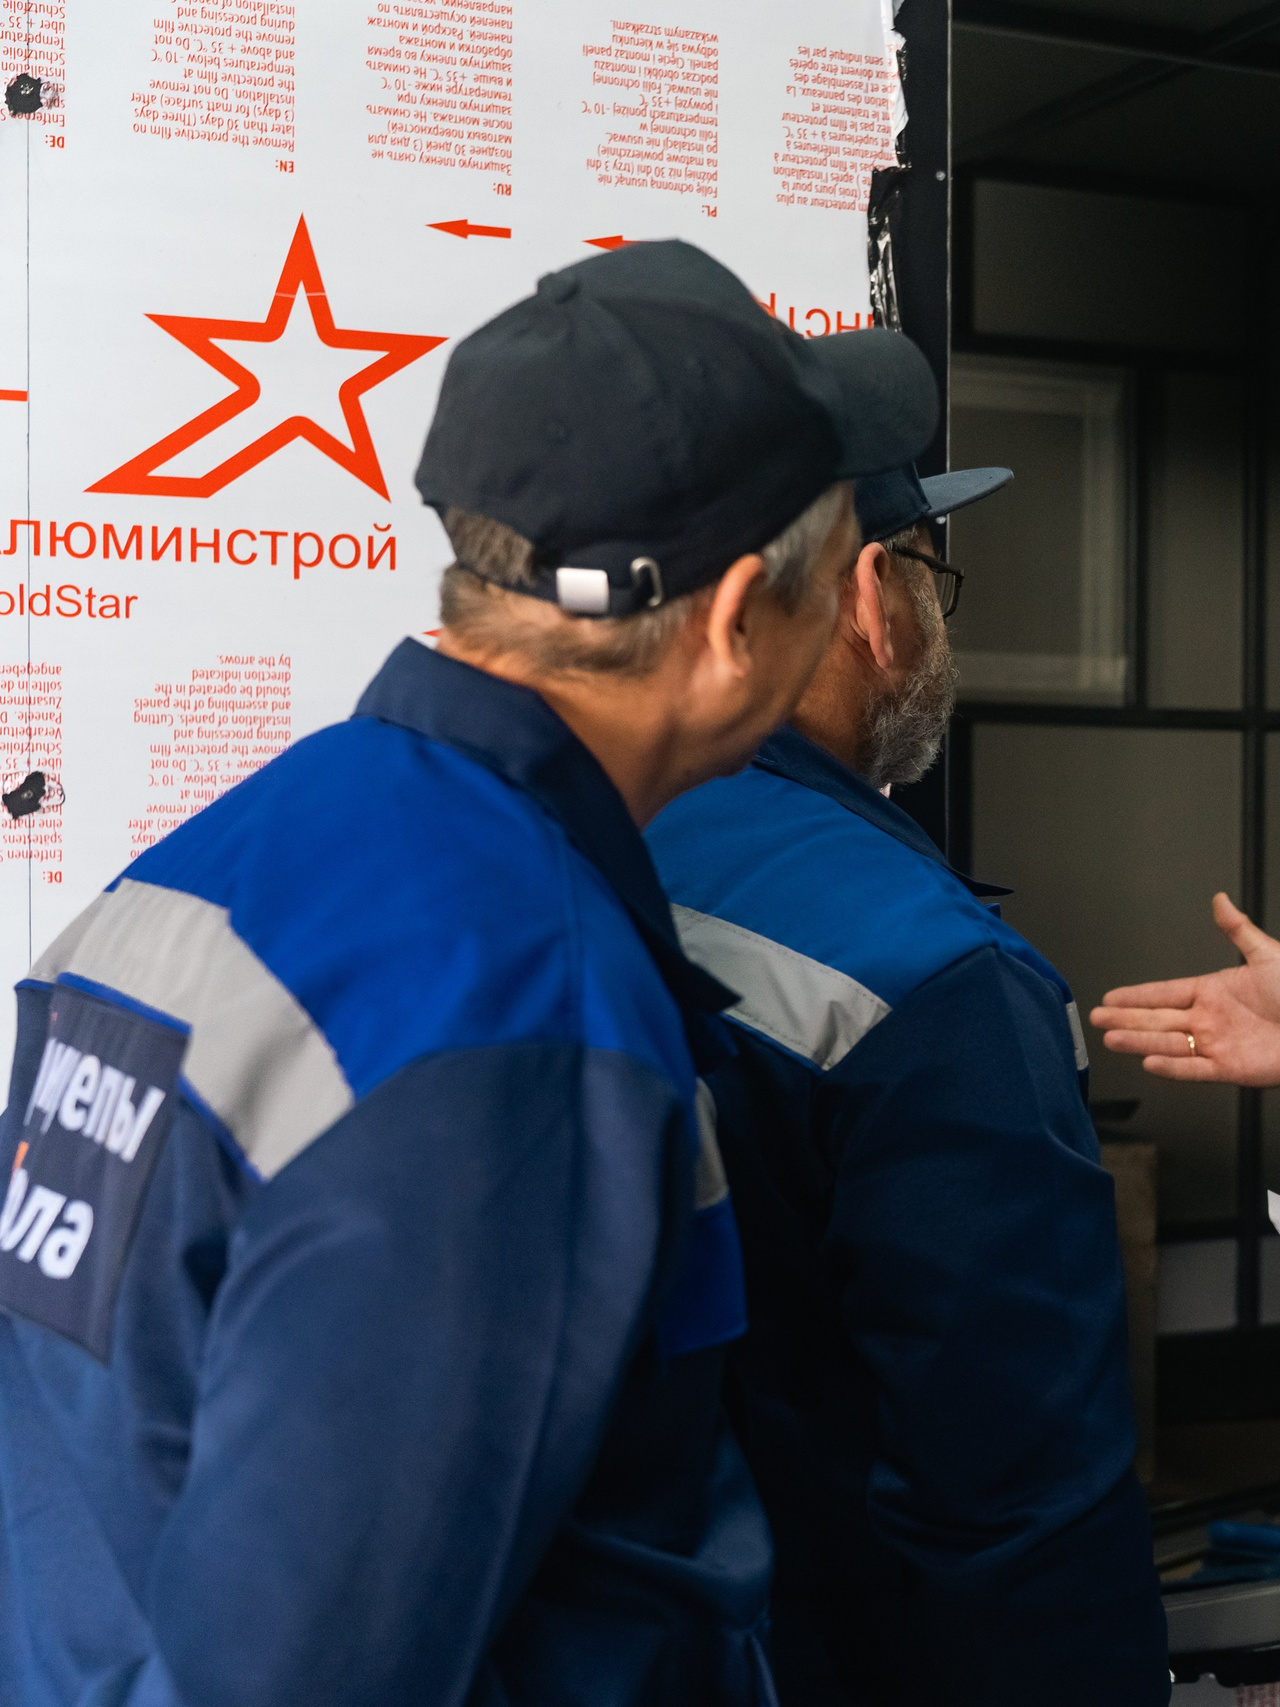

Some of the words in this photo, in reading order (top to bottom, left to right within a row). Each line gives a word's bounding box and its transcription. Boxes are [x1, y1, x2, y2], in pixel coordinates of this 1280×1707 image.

[176, 6, 197, 20] and
[234, 0, 295, 20] installation
[376, 3, 391, 14] по
[392, 5, 467, 24] осуществлять
[8, 15, 22, 29] 35
[199, 6, 257, 26] processing
[468, 16, 513, 30] панелей
[39, 19, 65, 35] über
[152, 18, 175, 34] film
[177, 21, 232, 39] protective
[259, 14, 295, 34] during
[367, 17, 409, 31] монтаж
[411, 22, 418, 32] и
[234, 29, 253, 44] the
[254, 31, 295, 45] remove
[420, 22, 463, 41] Раскрой
[466, 30, 512, 44] панелей.
[153, 34, 173, 47] not
[174, 36, 190, 51] Do
[398, 35, 446, 50] монтажа
[448, 42, 455, 51] и
[210, 41, 224, 55] 35
[239, 44, 272, 60] above
[366, 45, 402, 59] время
[457, 43, 512, 60] обработки
[798, 45, 809, 58] les
[812, 46, 826, 57] par
[1, 46, 65, 66] Schutzfolie
[164, 50, 184, 65] -10
[186, 53, 221, 70] below
[273, 49, 295, 62] and
[403, 51, 417, 61] во
[419, 49, 457, 66] пленку
[829, 48, 861, 65] indiqué
[864, 55, 882, 66] sens
[222, 57, 295, 79] temperatures
[365, 61, 410, 75] снимать
[459, 55, 511, 73] защитную
[182, 67, 193, 81] at
[196, 69, 218, 84] film
[413, 66, 427, 79] Не
[445, 70, 467, 83] +35
[149, 79, 190, 92] remove
[220, 72, 275, 89] protective
[276, 79, 295, 93] the
[394, 79, 412, 91] -10
[414, 81, 443, 93] ниже
[472, 74, 503, 86] выше
[505, 78, 512, 87] и
[192, 84, 211, 98] not
[213, 86, 229, 101] Do
[396, 91, 417, 105] при
[445, 82, 512, 101] температуре
[130, 92, 157, 107] after
[158, 92, 204, 111] surface)
[231, 89, 295, 108] installation.
[419, 93, 457, 109] пленку
[205, 101, 232, 115] matt
[234, 104, 249, 118] for
[251, 102, 282, 122] days)
[365, 104, 411, 118] снимать
[458, 98, 511, 115] защитную
[133, 105, 159, 124] days
[160, 111, 197, 128] (Three
[198, 112, 224, 131] days
[283, 107, 295, 123] (3
[412, 110, 427, 123] Не
[430, 112, 480, 126] монтажа.
[781, 112, 828, 127] protecteur
[131, 123, 147, 133] no
[225, 118, 240, 132] 30
[242, 120, 268, 135] than
[270, 123, 295, 138] later
[386, 118, 464, 139] поверхностей)
[482, 118, 513, 130] после
[829, 118, 847, 131] film
[849, 120, 858, 132] le
[859, 120, 875, 132] pas
[149, 125, 172, 140] film
[173, 127, 229, 144] protective
[367, 134, 388, 145] для
[466, 130, 513, 144] матовых
[44, 134, 65, 149] DE:
[230, 133, 250, 148] the
[251, 136, 295, 153] Remove
[389, 136, 410, 147] дня
[412, 136, 423, 151] (3
[425, 140, 452, 152] дней
[371, 149, 384, 159] не
[386, 150, 416, 162] снять
[453, 143, 466, 156] 30
[469, 145, 512, 158] позднее
[418, 150, 456, 166] пленку
[458, 155, 512, 175] Защитную
[274, 159, 294, 174] EN:
[491, 182, 512, 195] RU:
[0, 519, 397, 580] люминстрой
[0, 584, 138, 620] oldStar
[216, 655, 255, 664] arrows.
[257, 656, 275, 668] the
[278, 654, 291, 669] by
[191, 669, 241, 682] indicated
[243, 670, 291, 683] direction
[154, 684, 172, 696] the
[174, 684, 186, 697] in
[188, 682, 237, 697] operated
[239, 685, 253, 698] be
[254, 686, 290, 698] should
[134, 696, 170, 711] panels
[173, 699, 191, 712] the
[193, 699, 204, 712] of
[207, 697, 268, 712] assembling
[270, 701, 290, 713] and
